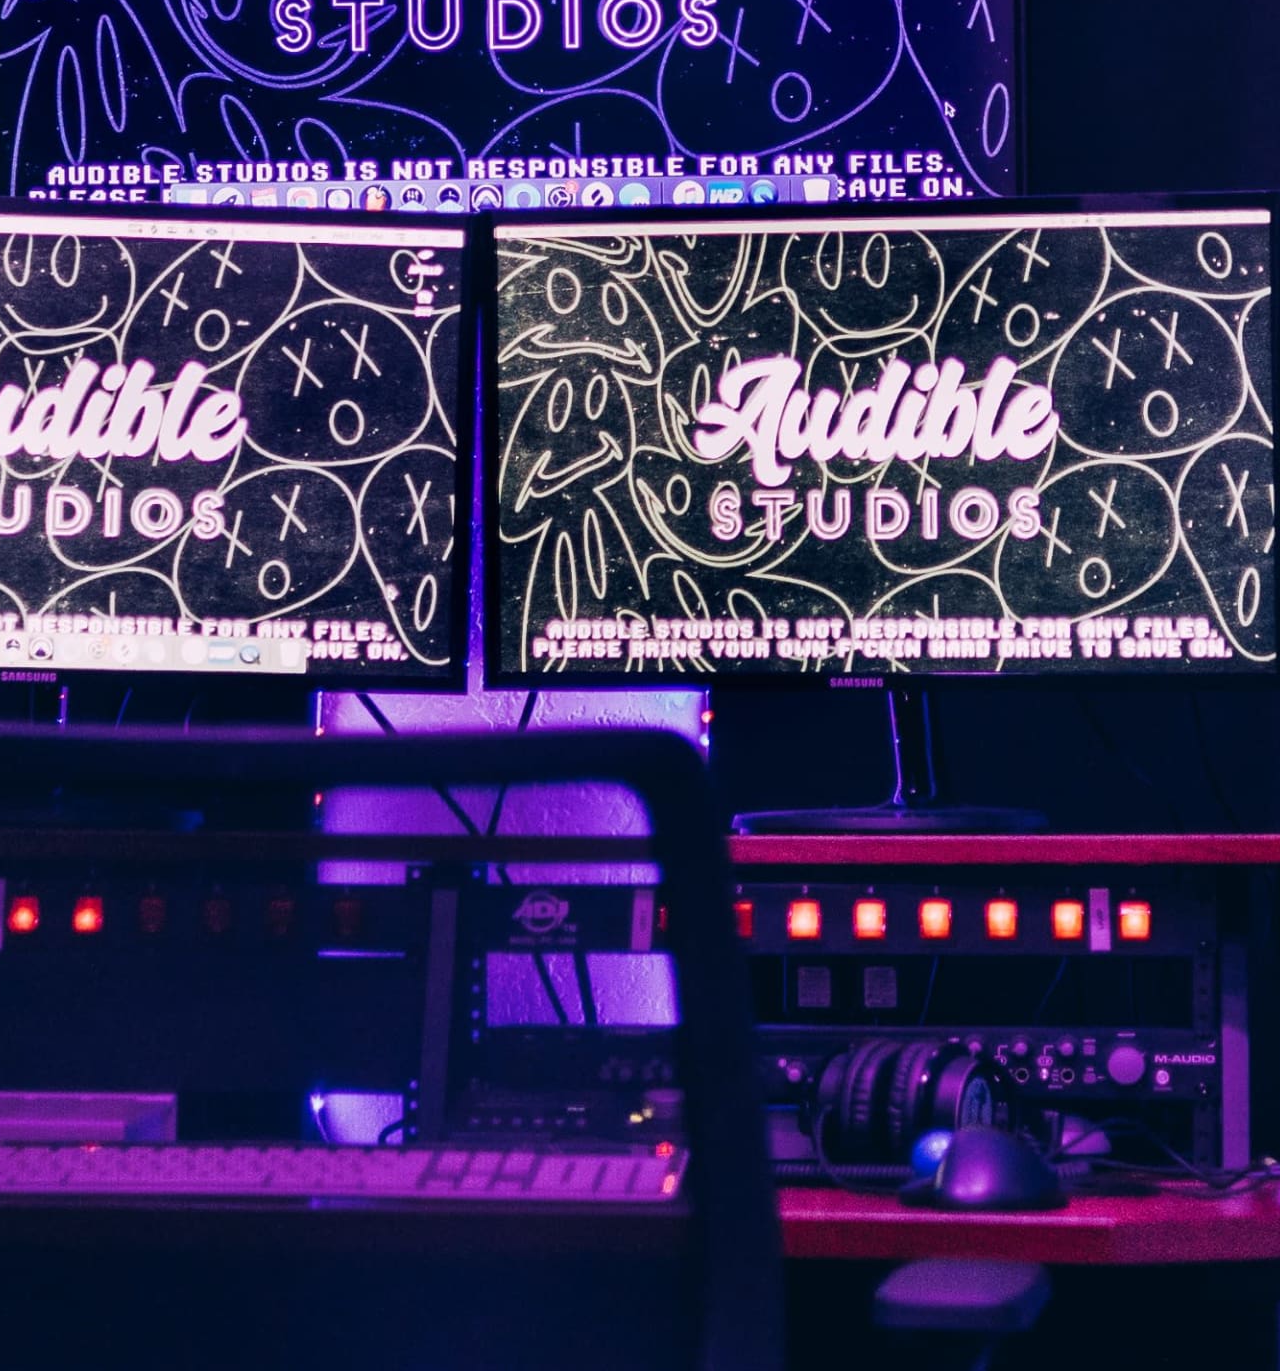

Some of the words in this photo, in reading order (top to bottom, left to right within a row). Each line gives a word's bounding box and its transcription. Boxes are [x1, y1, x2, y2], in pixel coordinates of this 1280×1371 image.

[47, 165, 180, 186] AUDIBLE
[196, 162, 330, 182] STUDIOS
[344, 161, 378, 180] IS
[393, 160, 452, 180] NOT
[468, 157, 684, 179] RESPONSIBLE
[700, 156, 758, 176] FOR
[774, 154, 834, 175] ANY
[849, 153, 954, 174] FILES.
[922, 177, 974, 197] ON.
[694, 357, 1060, 486] Audible
[711, 488, 1042, 541] STUDIOS
[28, 613, 194, 635] RESPONSIBLE
[202, 617, 251, 636] FOR
[257, 620, 308, 639] ANY
[546, 620, 649, 640] AUDIBLE
[656, 620, 754, 640] STUDIOS
[764, 619, 791, 640] IS
[797, 619, 845, 639] NOT
[854, 618, 1017, 639] RESPONSIBLE
[1023, 617, 1072, 639] FOR
[1076, 617, 1129, 639] ANY
[533, 639, 621, 659] PLEASE
[629, 640, 703, 659] BRING
[710, 640, 770, 659] YOUR
[777, 639, 830, 659] OWN
[927, 639, 992, 658] HARD
[997, 639, 1073, 658] DRIVE
[1080, 638, 1112, 657] TO
[1120, 638, 1183, 658] SAVE
[0, 671, 57, 683] SAMSUNG
[830, 677, 884, 688] SAMSUNG
[1154, 1054, 1216, 1064] M-AUDIO
